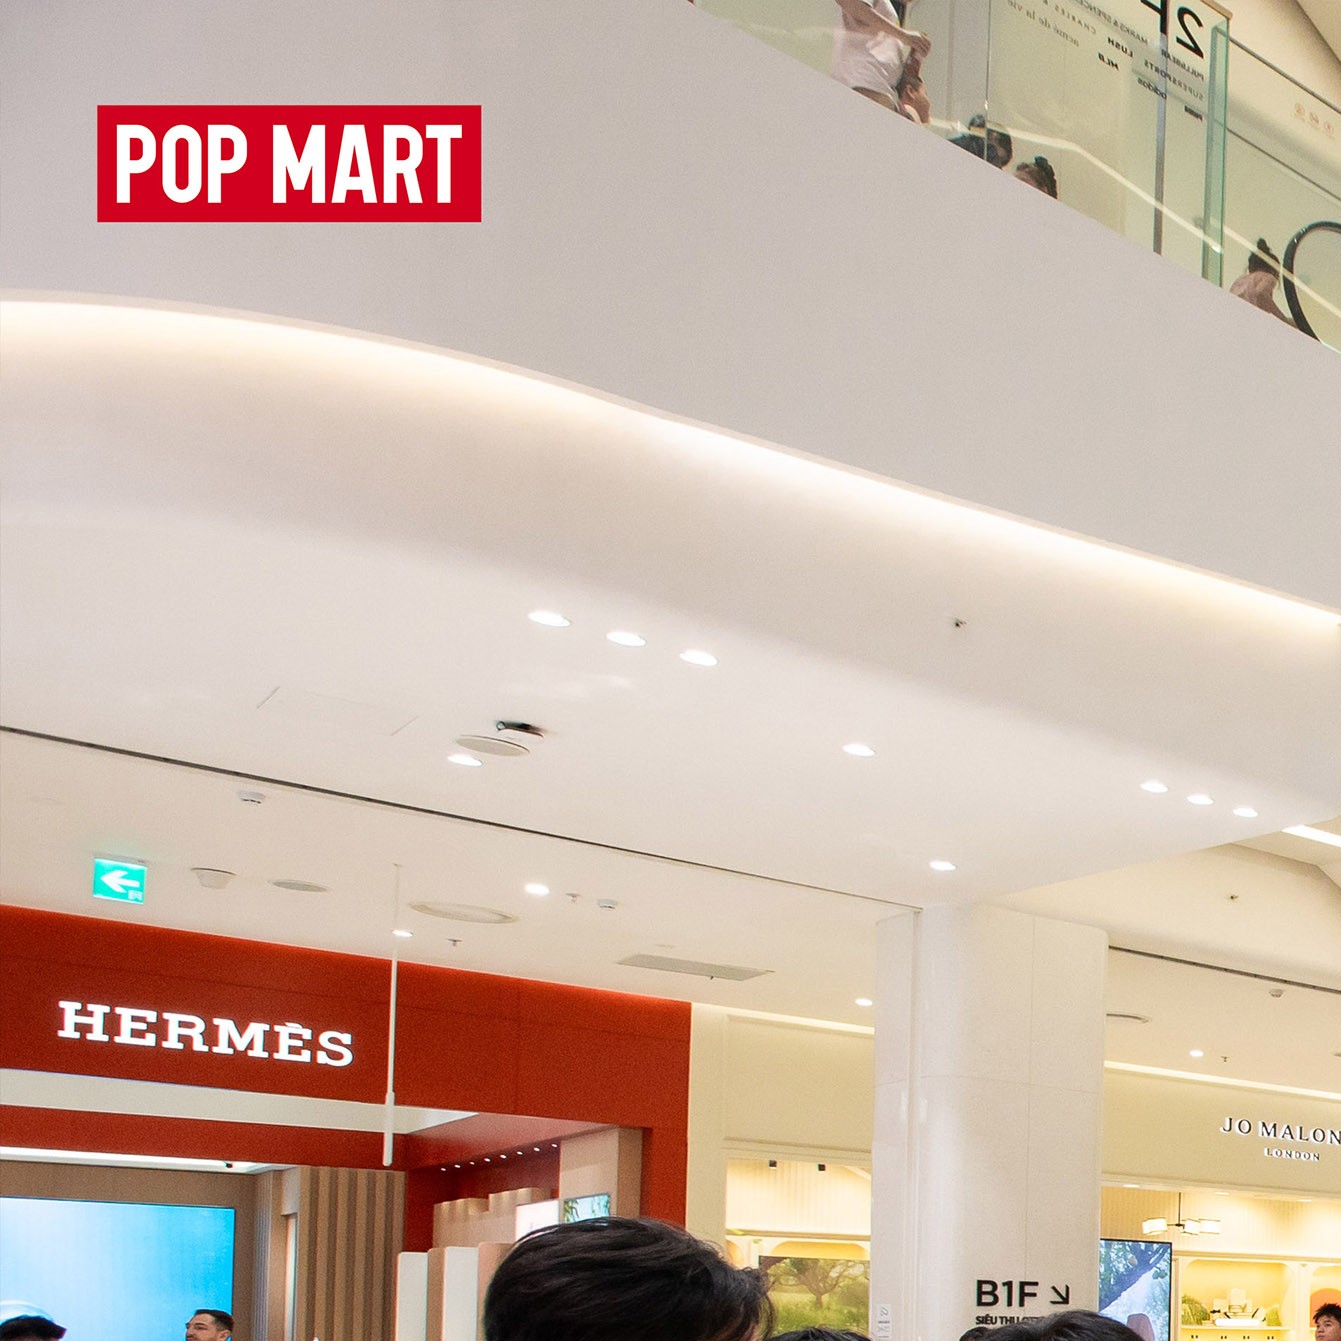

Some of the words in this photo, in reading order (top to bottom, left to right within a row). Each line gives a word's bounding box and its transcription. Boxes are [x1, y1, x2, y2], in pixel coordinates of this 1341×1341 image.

[56, 1000, 354, 1068] HERMÈS
[1220, 1117, 1252, 1135] JO
[1264, 1147, 1321, 1162] LONDON
[975, 1279, 1040, 1308] B1F
